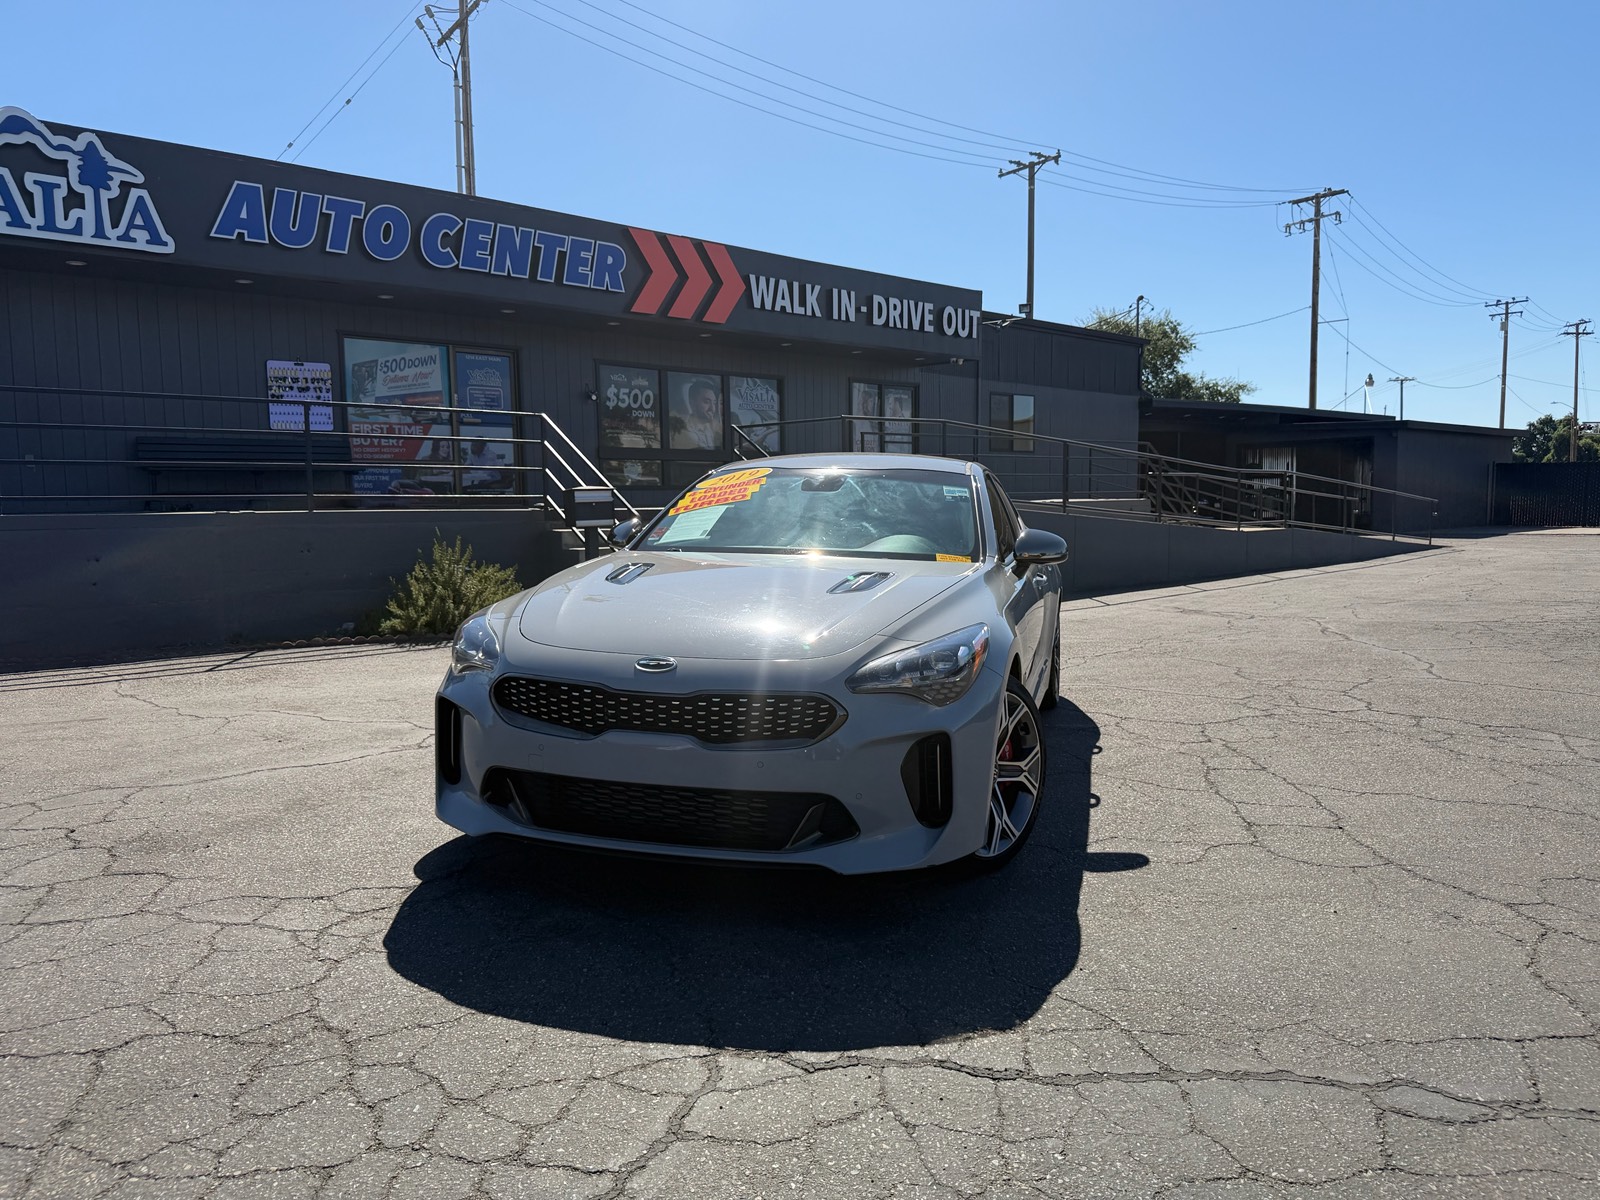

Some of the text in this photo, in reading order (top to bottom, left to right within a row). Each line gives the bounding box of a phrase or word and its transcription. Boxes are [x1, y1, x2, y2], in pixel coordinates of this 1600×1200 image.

[210, 180, 411, 261] AUTO
[420, 212, 626, 292] CENTER
[749, 274, 822, 318] WALK
[942, 306, 980, 339] OUT
[379, 354, 437, 374] $500 DOWN
[606, 384, 654, 410] $500
[736, 387, 776, 403] VISALIA
[632, 410, 655, 418] DOWN
[352, 424, 423, 435] FIRST TIME
[352, 437, 404, 446] BUYER?
[710, 469, 760, 486] 2019
[688, 478, 762, 497] 4-CYLINDER
[690, 487, 749, 503] LOADED
[673, 493, 748, 514] TURBO
